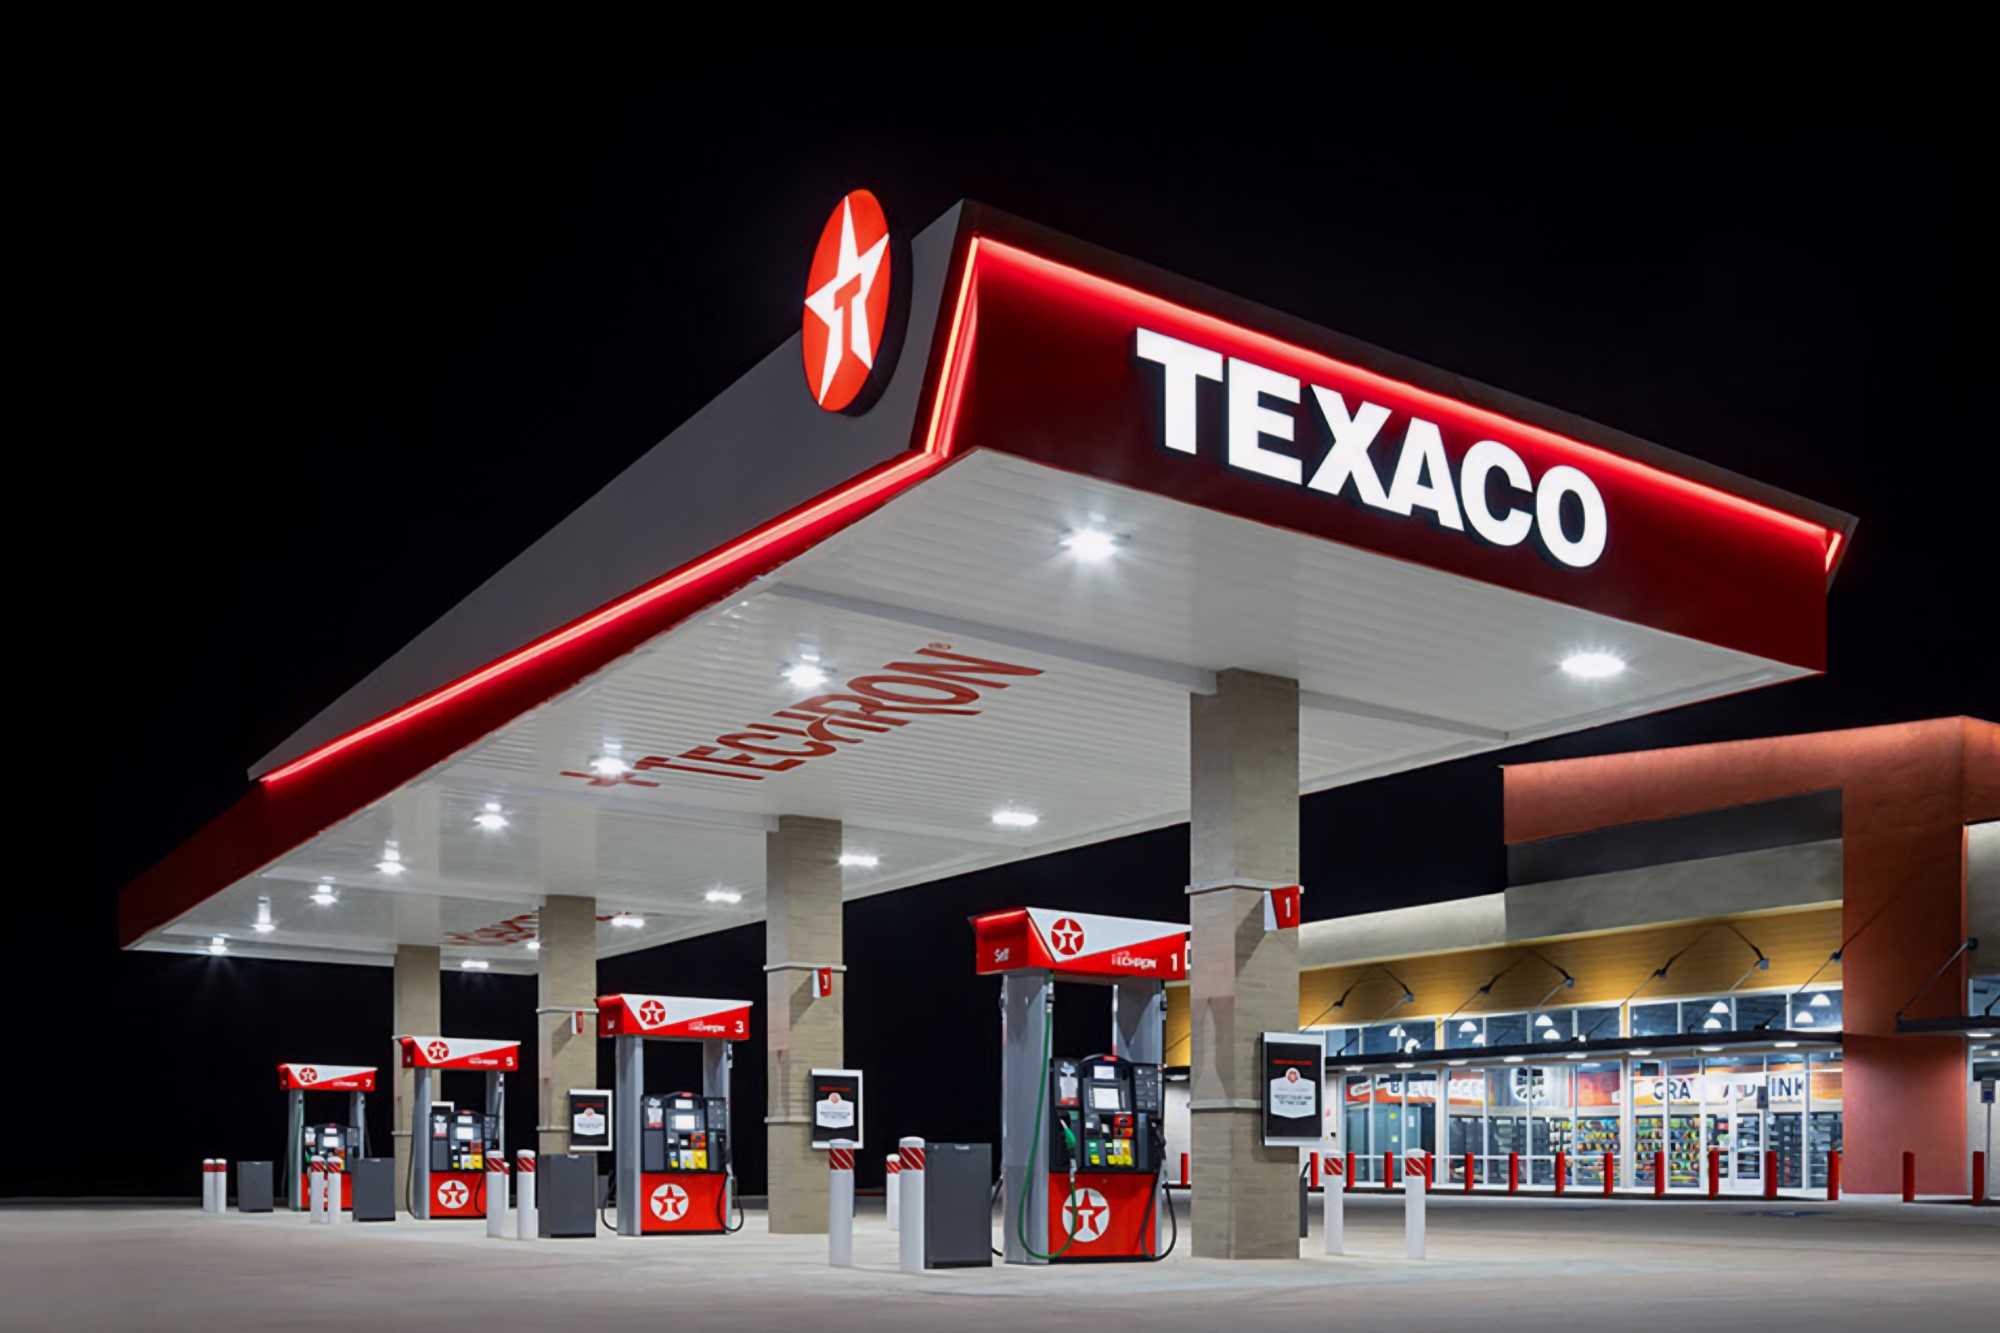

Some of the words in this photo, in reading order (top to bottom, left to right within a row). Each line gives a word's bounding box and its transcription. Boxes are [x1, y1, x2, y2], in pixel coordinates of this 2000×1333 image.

[1136, 327, 1607, 568] TEXACO
[1285, 896, 1291, 918] 1
[1170, 952, 1178, 972] 1
[735, 1020, 744, 1033] 3
[1653, 1081, 1692, 1101] GRA
[1743, 1077, 1804, 1098] DINK
